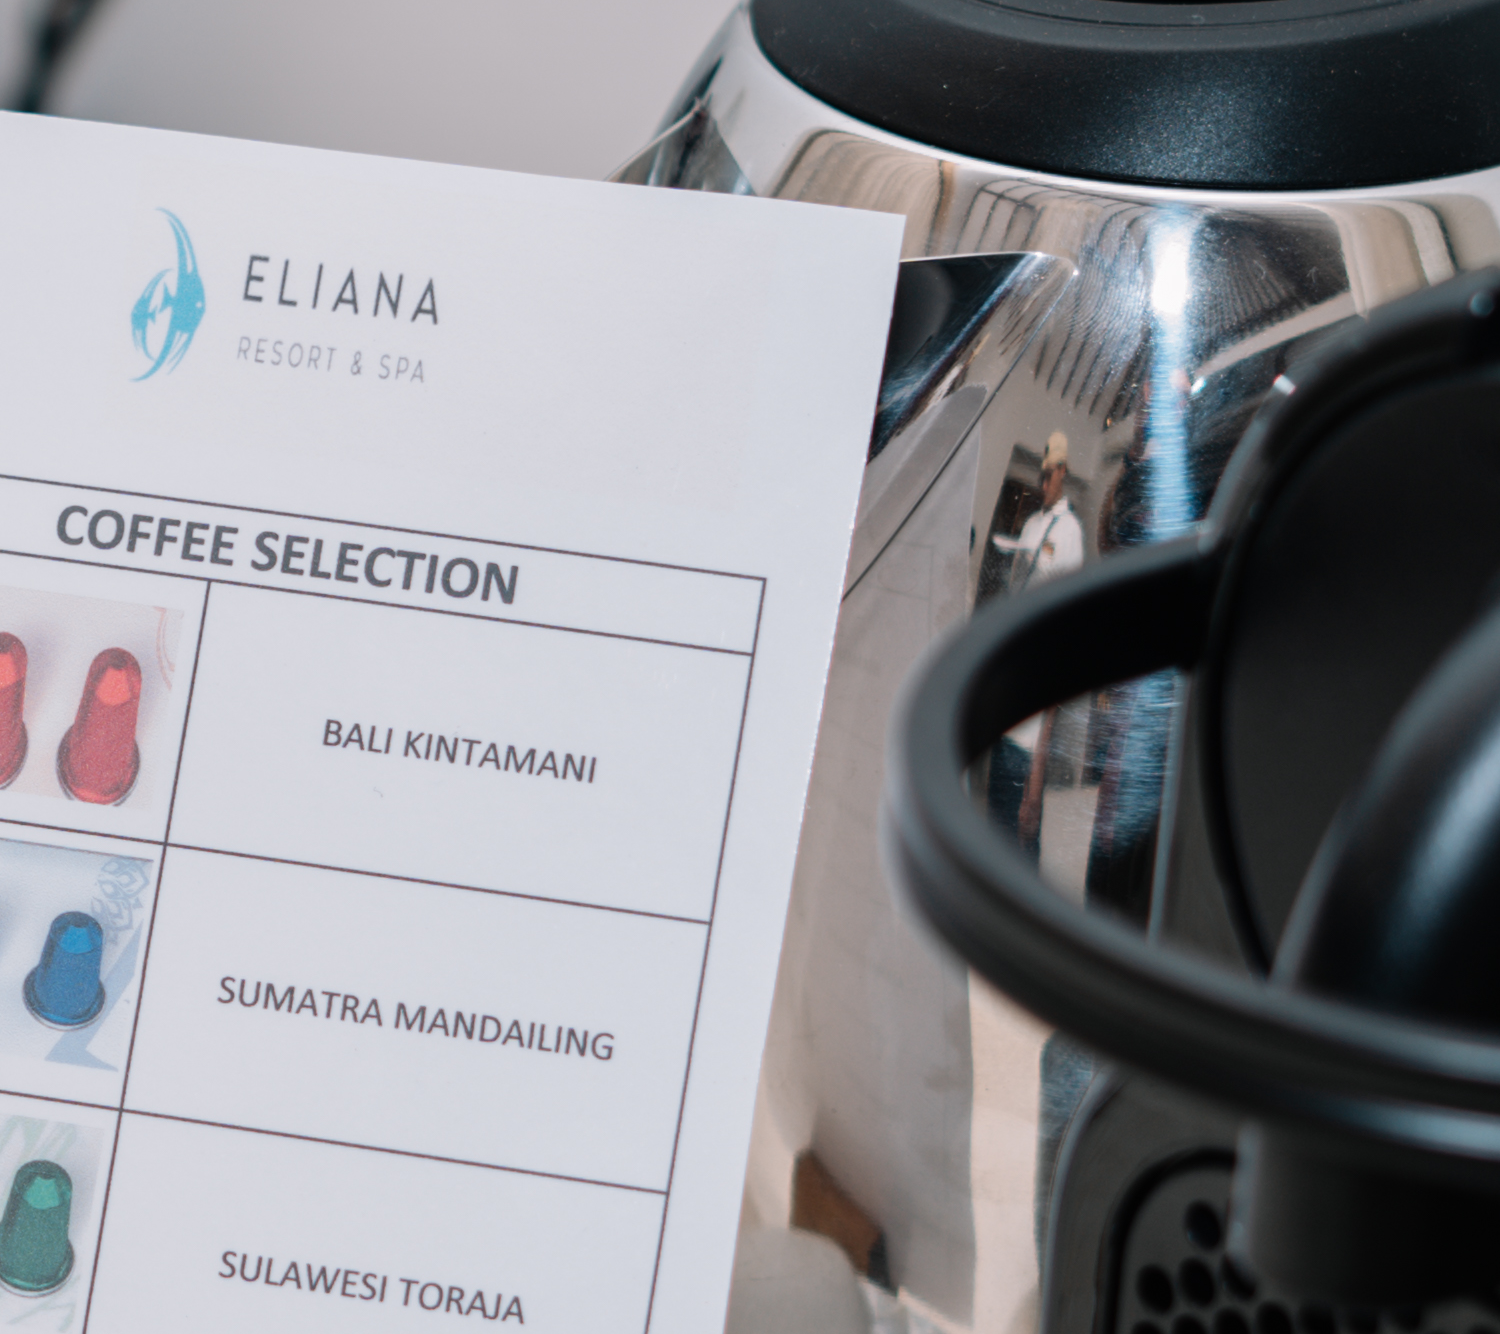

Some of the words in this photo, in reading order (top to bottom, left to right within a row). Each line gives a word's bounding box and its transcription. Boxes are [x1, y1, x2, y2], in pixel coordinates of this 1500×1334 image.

[242, 253, 439, 326] ELIANA
[236, 335, 337, 372] RESORT
[349, 349, 363, 377] &
[377, 353, 425, 384] SPA
[56, 504, 239, 567] COFFEE
[250, 530, 520, 605] SELECTION
[322, 718, 394, 755] BALI
[402, 730, 598, 784] KINTAMANI
[216, 975, 384, 1028] SUMATRA
[393, 1001, 615, 1062] MANDAILING
[217, 1250, 388, 1303] SULAWESI
[398, 1277, 525, 1326] TORAJA
